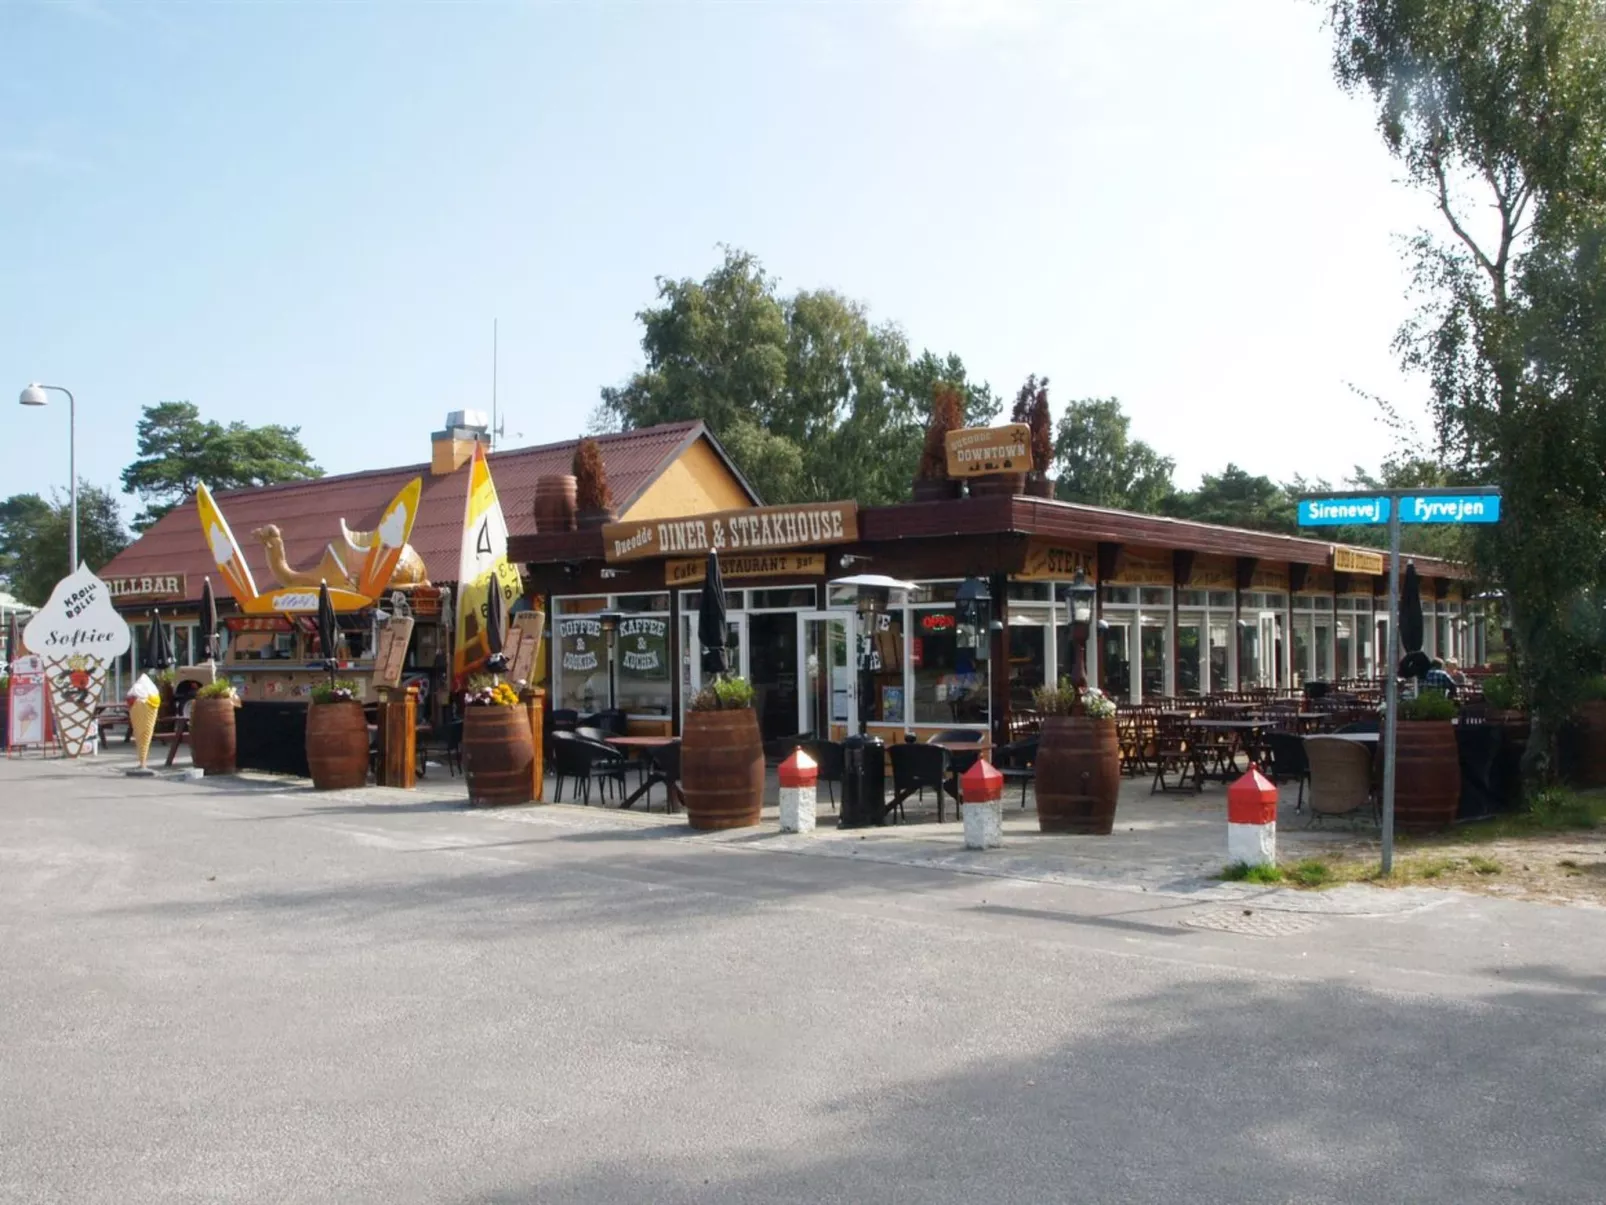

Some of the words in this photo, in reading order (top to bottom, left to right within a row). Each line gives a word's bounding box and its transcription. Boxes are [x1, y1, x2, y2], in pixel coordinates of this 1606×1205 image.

[957, 443, 1026, 463] DOWNTOWN
[1308, 501, 1380, 522] Sirenevej
[1414, 497, 1484, 521] Fyrvejen
[657, 520, 709, 551] DINER
[712, 519, 726, 548] &
[729, 510, 844, 549] STEAKHOUSE
[705, 557, 788, 575] STAURANT
[105, 577, 179, 596] RILLBAR
[559, 620, 602, 637] COFFEE
[619, 619, 666, 637] KAFFEE
[922, 615, 956, 628] OPEN
[576, 637, 586, 651] &
[637, 637, 647, 650] &
